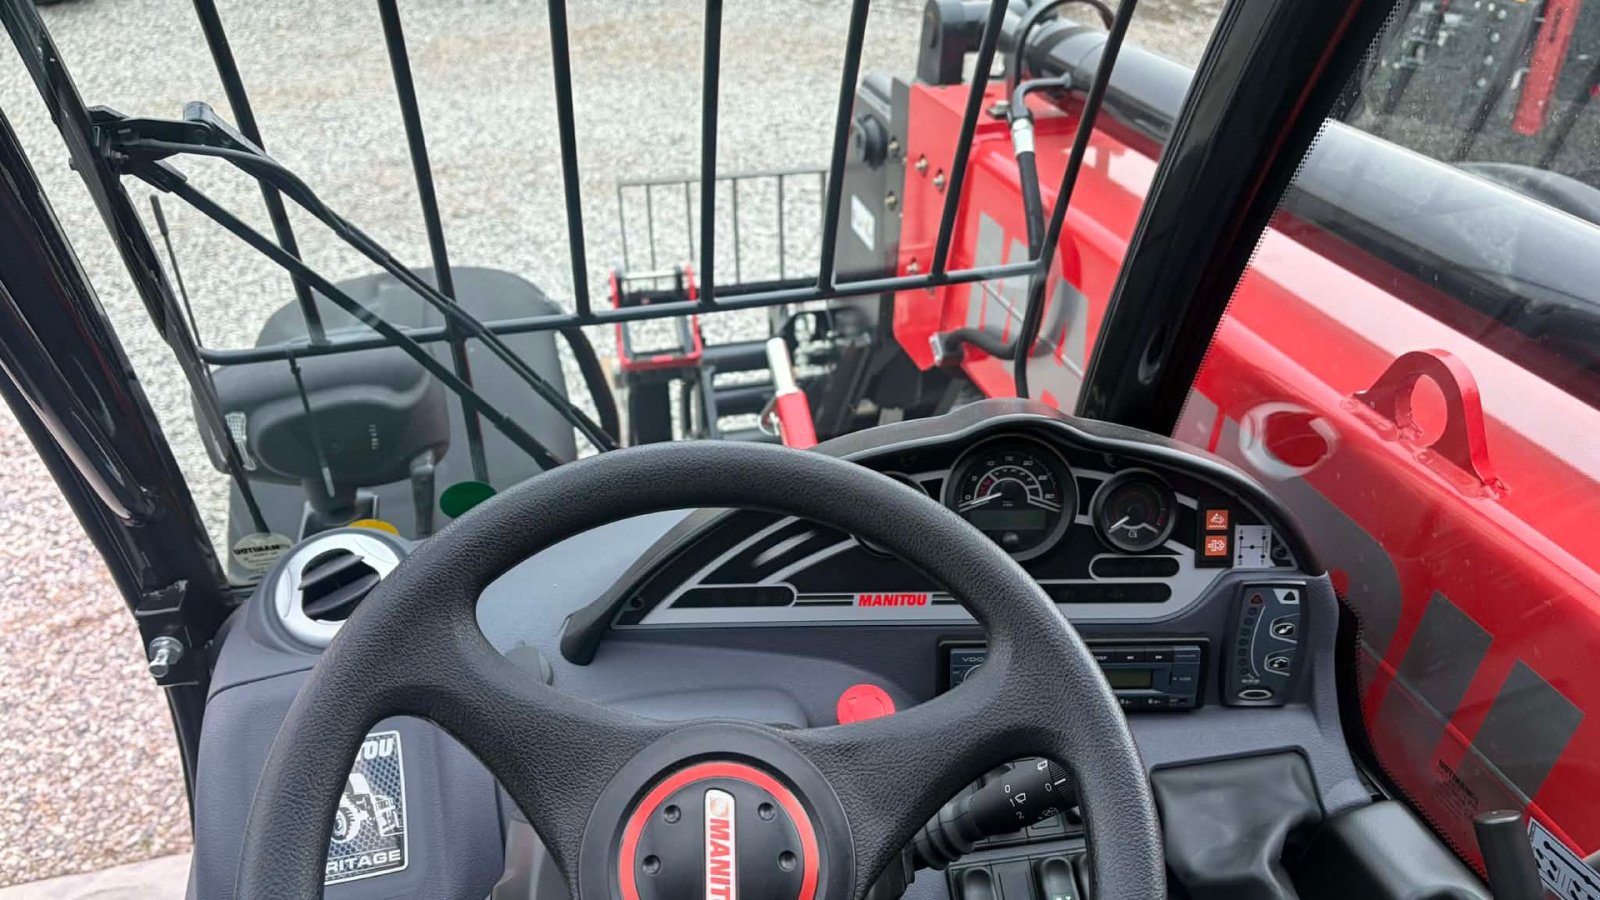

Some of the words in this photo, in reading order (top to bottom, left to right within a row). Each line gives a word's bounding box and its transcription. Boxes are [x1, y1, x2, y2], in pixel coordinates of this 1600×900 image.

[858, 593, 928, 607] MANITOU
[1004, 784, 1011, 793] 0
[1044, 782, 1052, 792] 0
[1015, 811, 1025, 820] 2
[709, 818, 731, 900] MANIT
